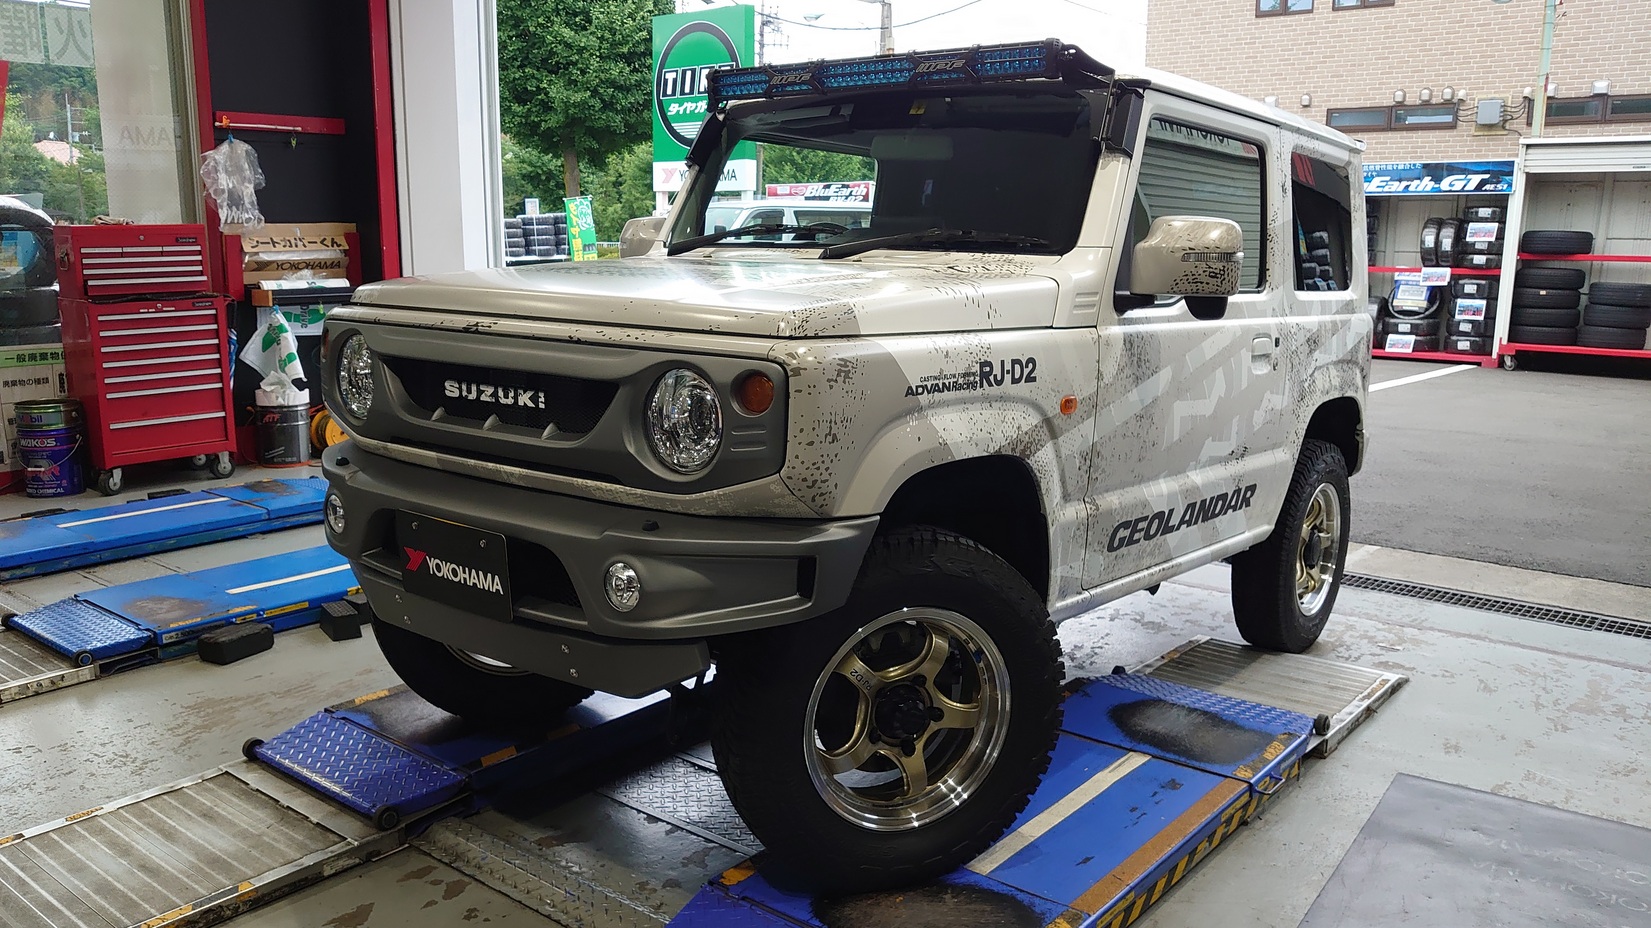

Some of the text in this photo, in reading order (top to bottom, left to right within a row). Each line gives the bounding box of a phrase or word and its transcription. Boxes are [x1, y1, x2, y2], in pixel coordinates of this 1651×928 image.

[805, 184, 868, 197] BluEarth
[248, 237, 342, 249] シートカバーくん
[275, 260, 342, 271] YOKOHAMA
[979, 356, 1037, 389] RJ-D2
[444, 379, 546, 409] SUZUKI
[1106, 483, 1258, 553] GEOLANDAR
[425, 555, 504, 595] YOKOHAMA
